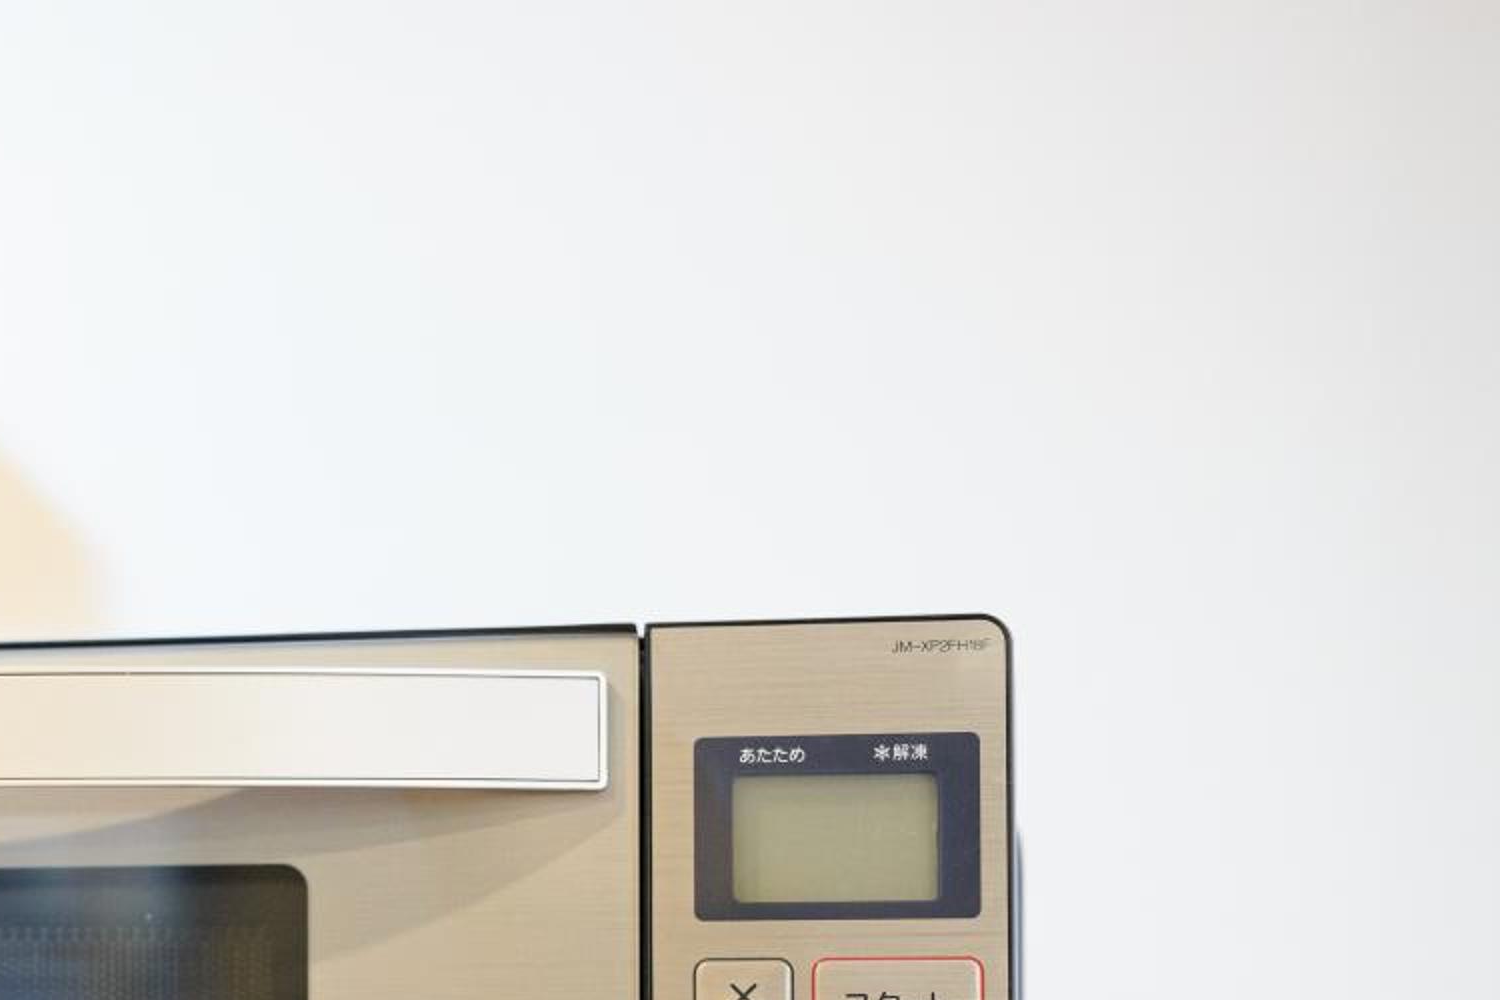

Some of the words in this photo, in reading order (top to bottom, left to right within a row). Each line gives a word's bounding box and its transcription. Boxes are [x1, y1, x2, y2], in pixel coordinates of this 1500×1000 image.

[739, 747, 805, 763] あたため
[892, 743, 929, 761] 解凍
